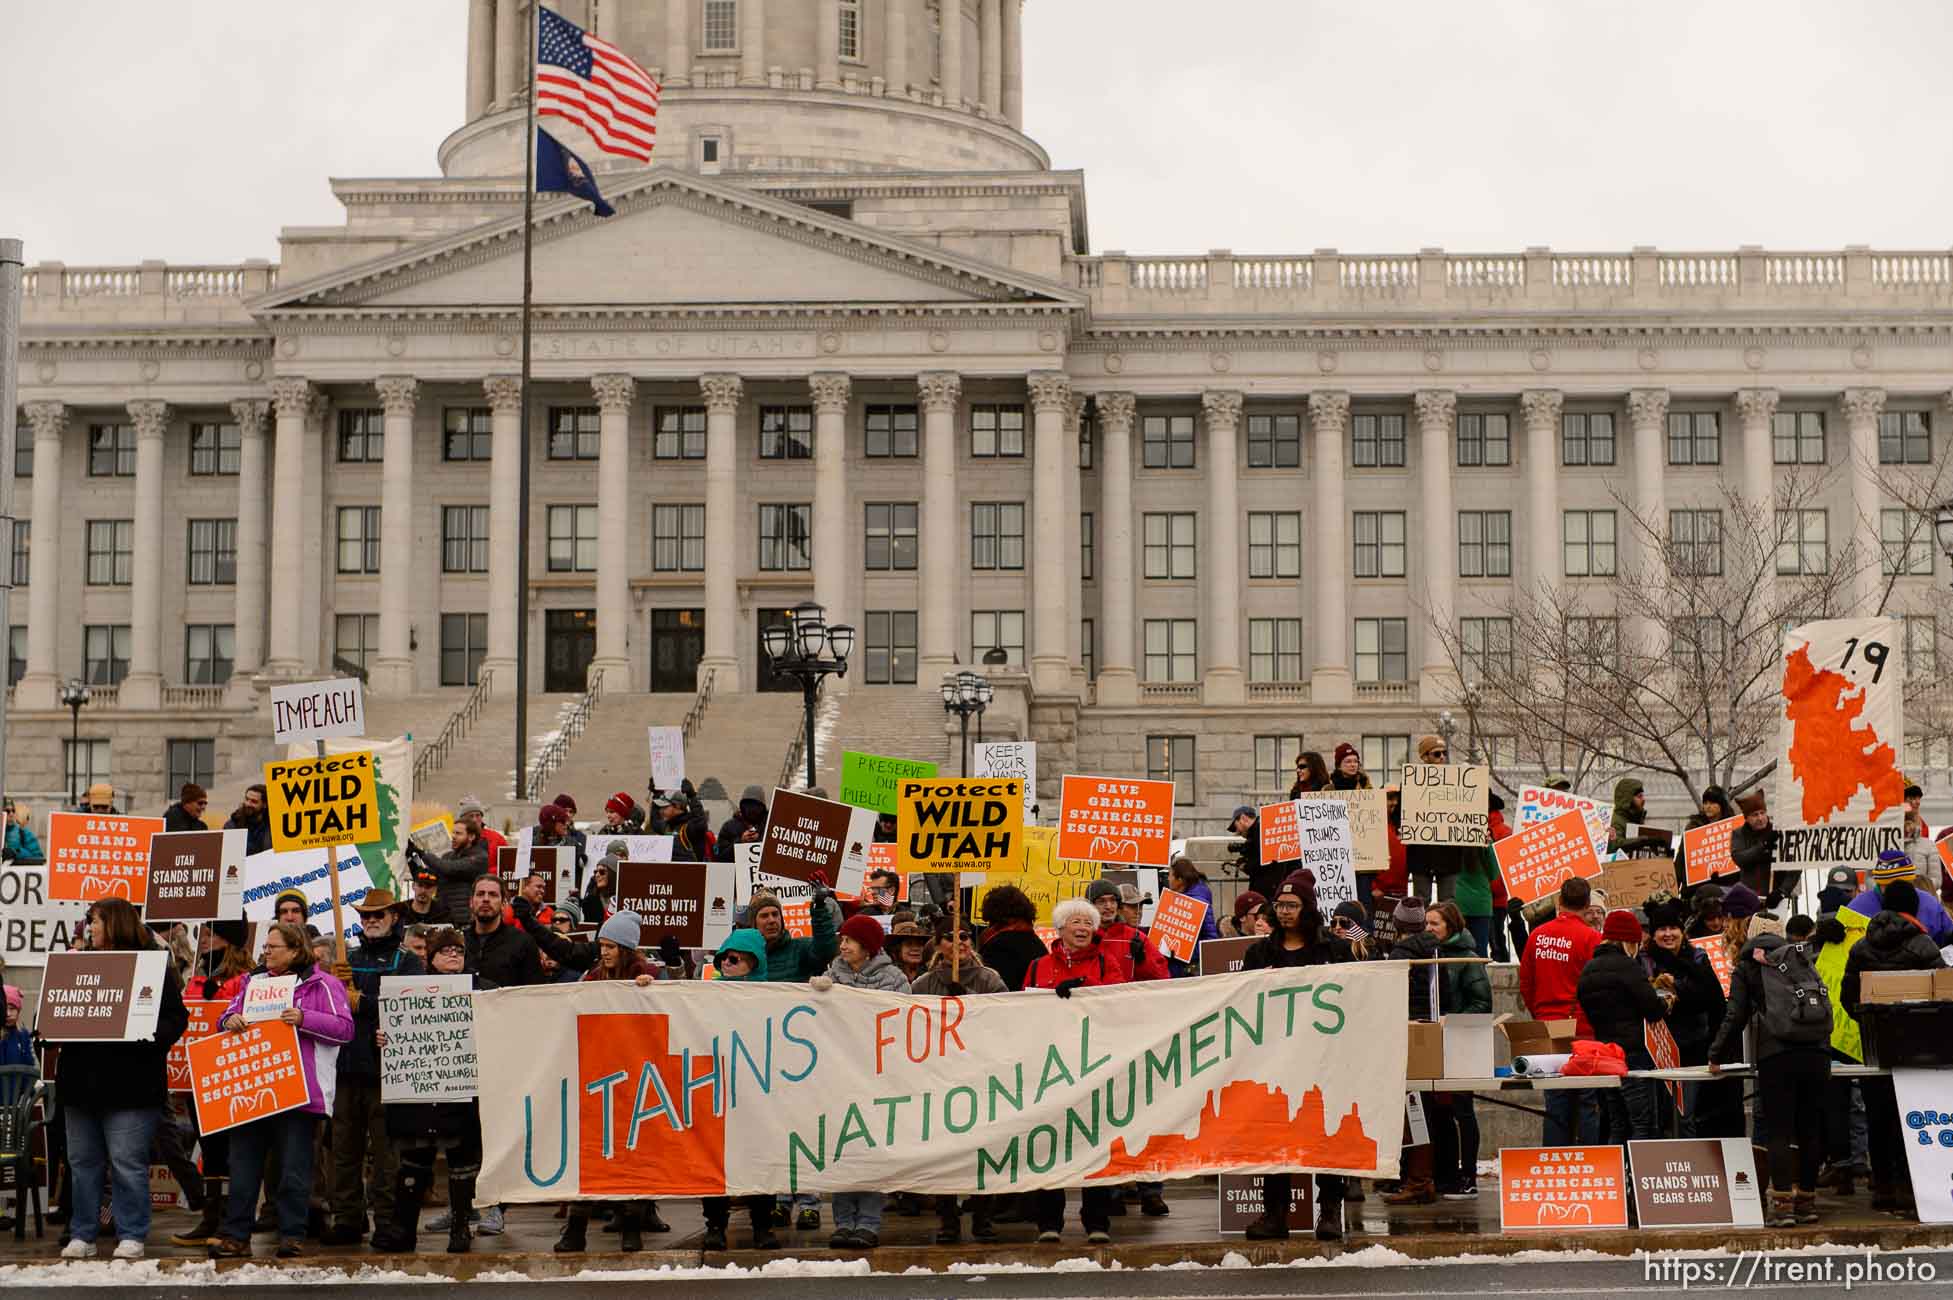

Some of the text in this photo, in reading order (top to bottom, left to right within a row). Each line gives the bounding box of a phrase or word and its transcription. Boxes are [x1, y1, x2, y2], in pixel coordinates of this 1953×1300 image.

[551, 336, 784, 355] STATE OF UTAH
[274, 690, 356, 734] IMPEACH
[985, 745, 1023, 760] KEEP
[271, 755, 368, 781] Protect
[858, 757, 926, 778] PRESERVE
[987, 757, 1026, 772] YOUR
[1404, 765, 1477, 788] PUBLIC
[281, 774, 362, 807] WILD
[904, 783, 1018, 798] Protect
[1097, 784, 1139, 795] SAVE
[1088, 797, 1147, 809] GRAND
[914, 801, 1008, 827] WILD
[1069, 810, 1164, 825] STAIRCASE
[1322, 803, 1348, 821] SHRINK
[1416, 812, 1448, 823] NOT
[1447, 812, 1488, 826] OWNED
[86, 820, 129, 832] SAVE
[282, 804, 368, 838] UTAH
[798, 816, 820, 830] UTAH
[1067, 823, 1165, 838] ESCALANTE
[1306, 826, 1341, 844] TRUMPS
[1402, 825, 1419, 841] BY
[1420, 826, 1447, 842] OIL
[1522, 823, 1556, 844] SAVE
[1706, 823, 1733, 836] SAVE
[77, 835, 137, 847] GRAND
[771, 827, 838, 853] STANDS WITH
[910, 832, 1011, 860] UTAH
[1520, 832, 1566, 857] GRAND
[1702, 832, 1729, 845] GRAN
[776, 844, 804, 859] BEARS
[806, 850, 828, 865] EARS
[1340, 847, 1350, 863] BY
[1508, 836, 1584, 874] STAIRCASE
[1691, 841, 1730, 857] STAIRC
[175, 855, 194, 866] UTAH
[930, 860, 991, 870] www.suwa.org
[1511, 846, 1589, 886] ESCALANTE
[1691, 850, 1731, 867] ESCALA
[55, 863, 150, 876] ESCALANT
[153, 868, 214, 884] STANDS WITH
[1320, 864, 1345, 883] 85%
[1650, 872, 1676, 889] SAD
[159, 885, 207, 898] BEARS EARS
[649, 884, 673, 895] UTAH
[1315, 885, 1352, 900] MPEACH
[623, 898, 697, 912] STANDS WITH
[1174, 897, 1192, 909] SAVE
[641, 915, 689, 927] ARS EARS
[6, 919, 80, 953] BEA
[1536, 934, 1572, 949] Sign the
[1229, 960, 1244, 971] UTA
[76, 975, 100, 986] UTAH
[48, 989, 124, 1002] STANDS WITH
[53, 1005, 113, 1017] BEARS EARS
[381, 998, 398, 1012] TO
[400, 996, 436, 1012] THOSE
[389, 1010, 473, 1027] OF IMAGINATION
[222, 1028, 262, 1049] SAVE
[436, 1029, 470, 1042] PLACE
[876, 995, 966, 1074] FOR
[216, 1041, 272, 1066] GRAND
[383, 1047, 403, 1058] ON
[201, 1050, 292, 1088] STAIRCASE
[202, 1065, 297, 1104] ESCALANTE
[380, 1073, 404, 1085] THE
[405, 1071, 433, 1083] MOST
[411, 1082, 440, 1093] PART
[976, 983, 1346, 1191] MONUMENTS
[525, 1005, 817, 1188] UTAHNS
[789, 1016, 1111, 1193] NATIONAL
[1538, 1152, 1585, 1163] SAVE
[1529, 1164, 1595, 1176] GRAND
[1665, 1161, 1692, 1173] UTAH
[1511, 1176, 1616, 1189] STAIRCASE
[1641, 1175, 1720, 1190] STANDS WITH
[1510, 1190, 1617, 1202] ESCALANTE
[1653, 1192, 1713, 1204] BEARS EARS
